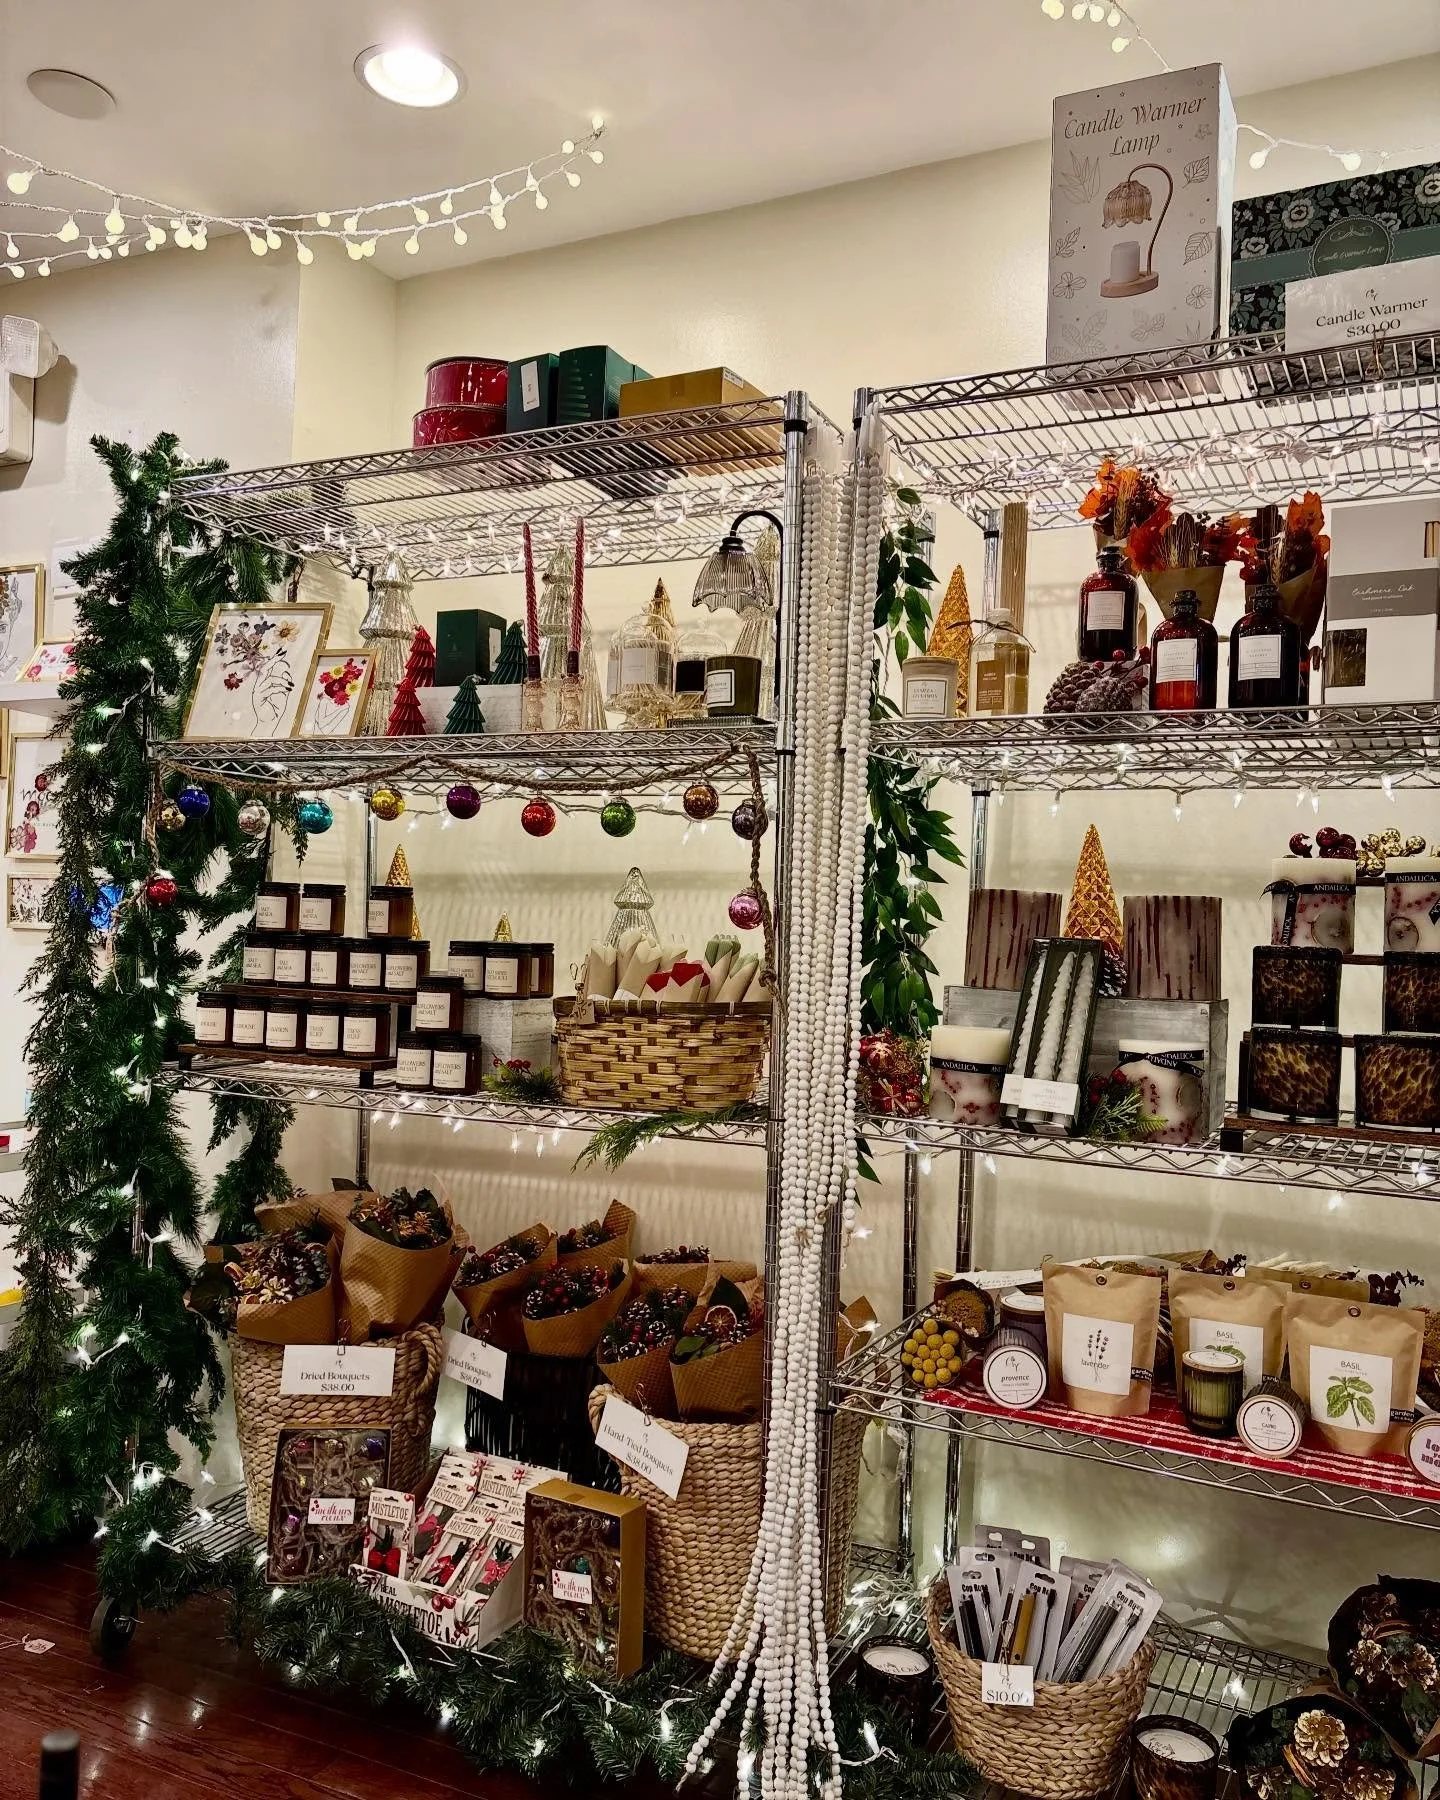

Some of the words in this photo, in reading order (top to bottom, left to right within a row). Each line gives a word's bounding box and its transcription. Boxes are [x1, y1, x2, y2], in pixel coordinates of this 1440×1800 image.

[1064, 108, 1124, 139] Candle
[1129, 96, 1207, 125] Warmer
[1108, 132, 1161, 158] Lamp
[1316, 309, 1366, 328] Candle
[1369, 298, 1430, 318] Warmer
[1346, 318, 1402, 339] $30.00
[1215, 1329, 1235, 1340] BASIL
[446, 1355, 465, 1371] Dried
[463, 1360, 493, 1381] Bouquets
[1080, 1357, 1111, 1371] lavender
[1339, 1359, 1362, 1372] BASIL
[299, 1370, 327, 1382] Dried
[326, 1371, 371, 1383] Bouquets
[458, 1370, 483, 1388] $38.00
[1000, 1374, 1031, 1385] provence
[320, 1382, 356, 1393] $38.00
[1389, 1408, 1416, 1419] garden
[602, 1422, 626, 1443] Hand
[625, 1435, 643, 1455] Tied
[641, 1446, 674, 1477] Bouquets
[625, 1451, 653, 1476] $38.00
[430, 1485, 468, 1509] MISTLETOE
[479, 1478, 517, 1498] MISTLETOE
[369, 1500, 410, 1521] MISTLETOE
[448, 1519, 487, 1539] MISTLETOE
